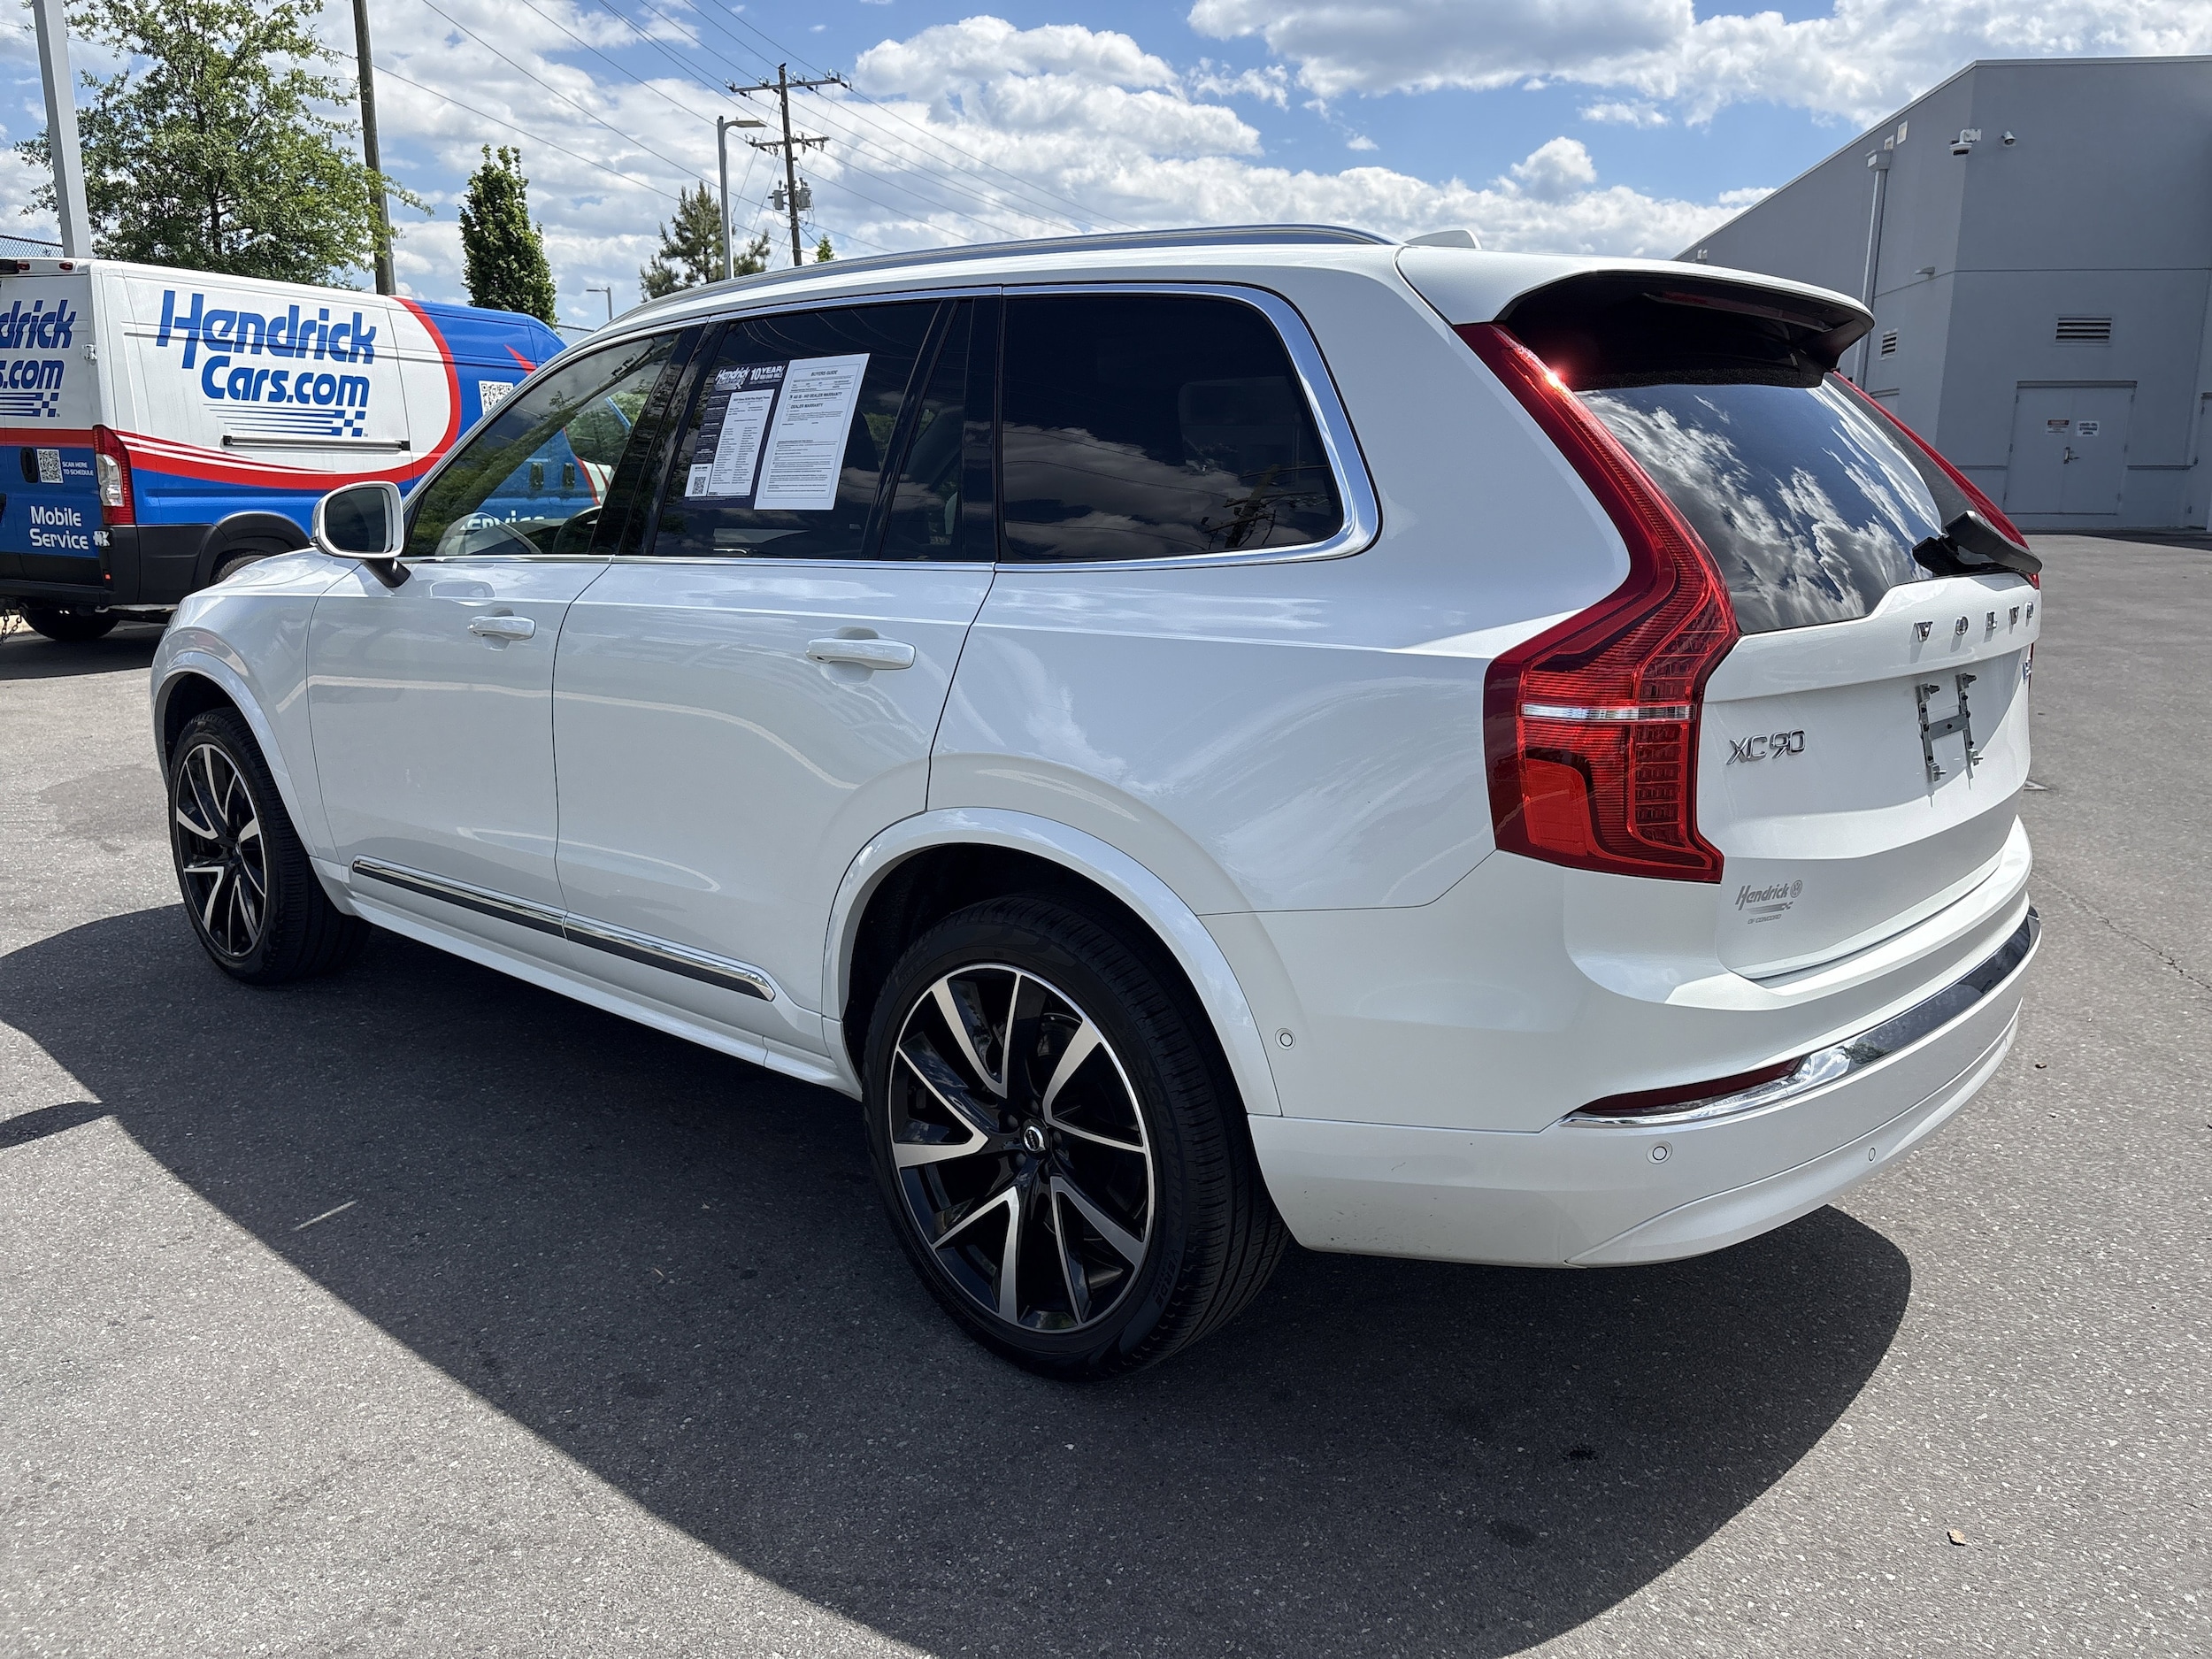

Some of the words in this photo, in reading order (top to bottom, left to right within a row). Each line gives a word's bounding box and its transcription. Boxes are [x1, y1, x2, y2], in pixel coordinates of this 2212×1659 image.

[157, 290, 377, 369] Hendrick
[202, 356, 370, 407] Cars.com
[715, 365, 750, 385] Hendrick
[750, 367, 761, 380] 10
[30, 505, 81, 526] Mobile
[29, 527, 89, 550] Service
[1914, 602, 2034, 642] VOLVO
[1725, 729, 1805, 765] XC90
[1734, 883, 1790, 910] Hendrick
